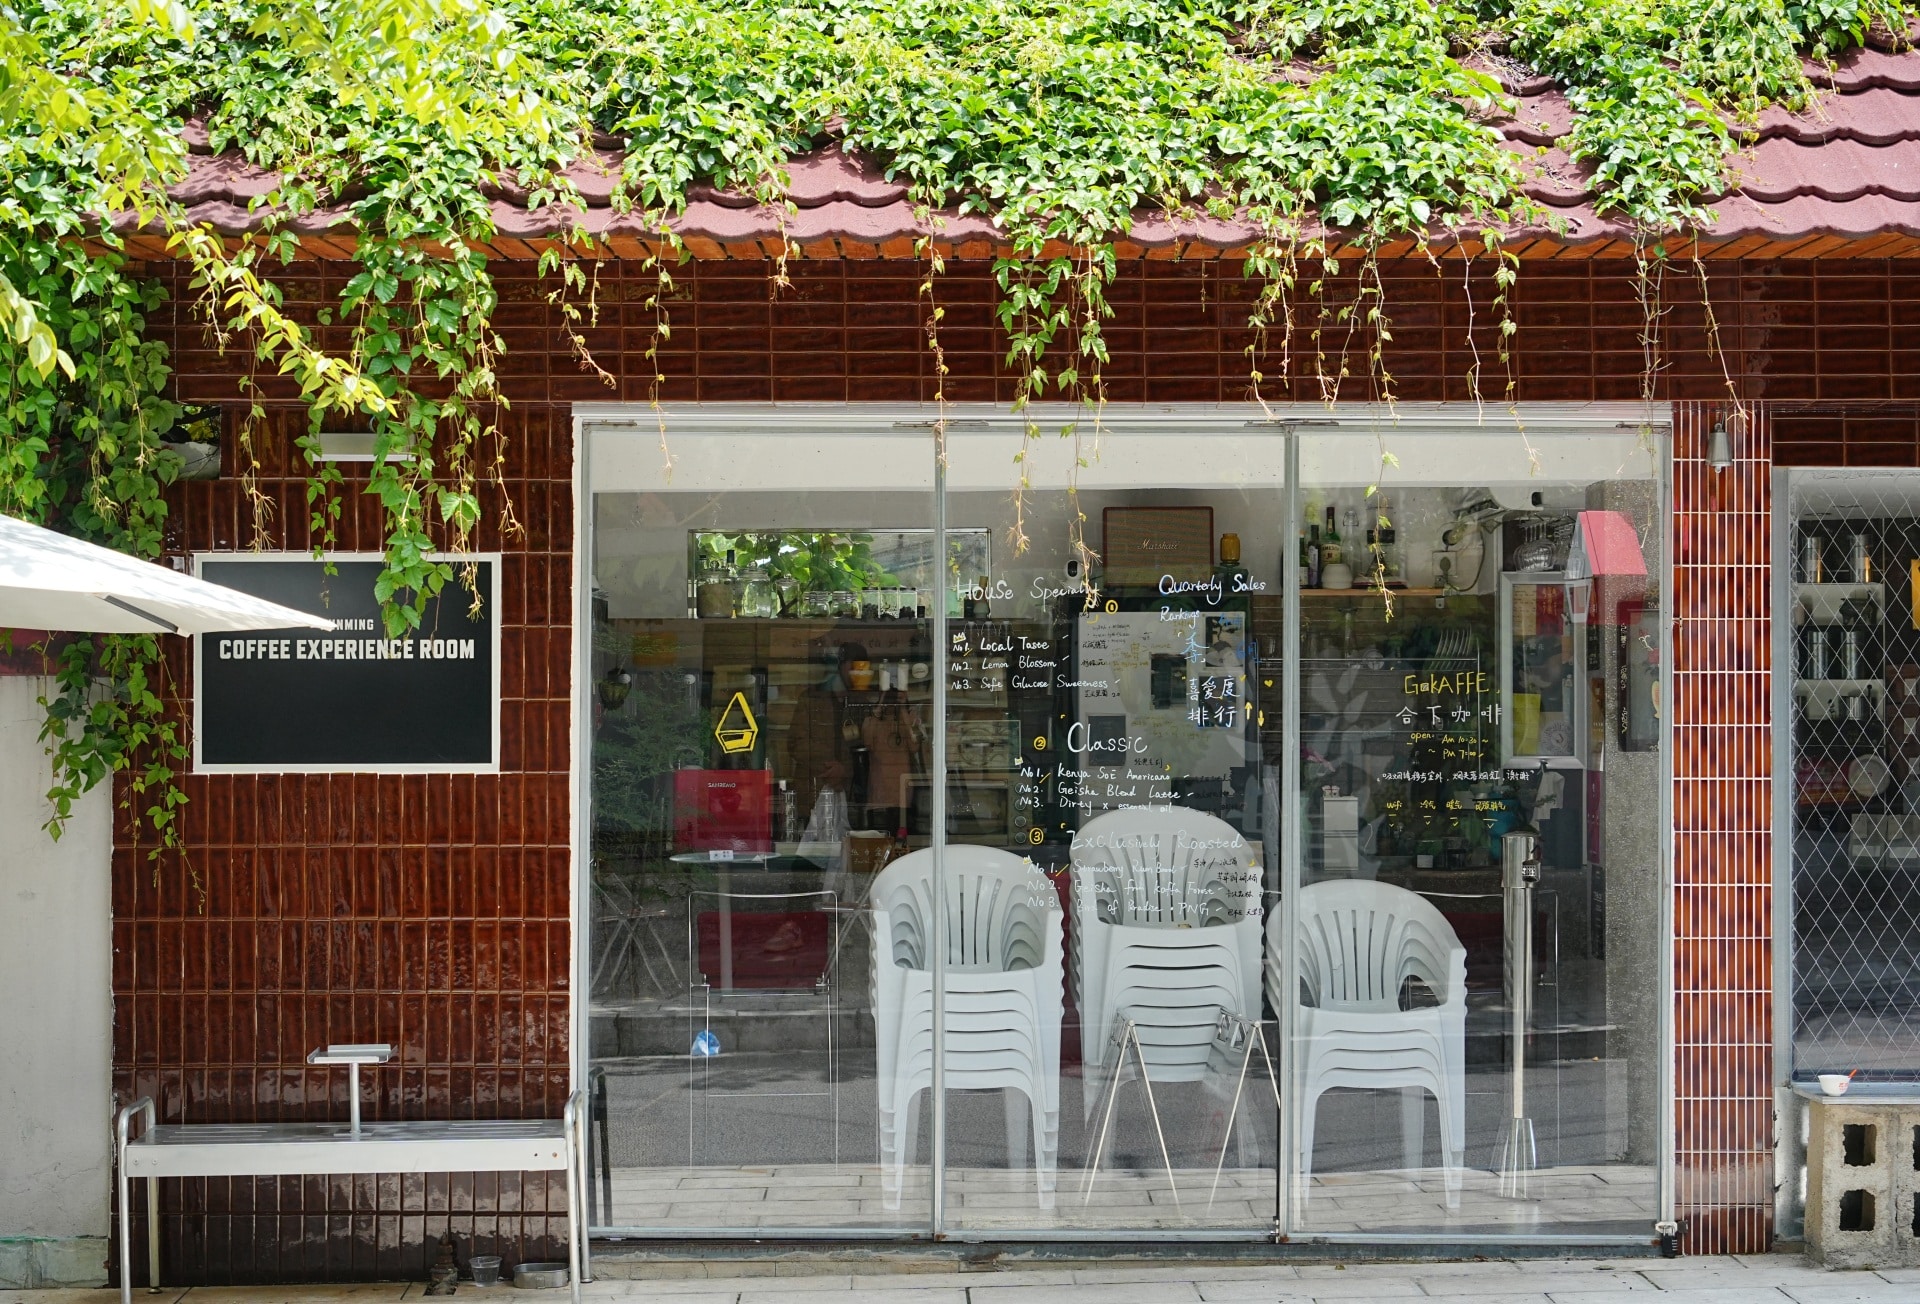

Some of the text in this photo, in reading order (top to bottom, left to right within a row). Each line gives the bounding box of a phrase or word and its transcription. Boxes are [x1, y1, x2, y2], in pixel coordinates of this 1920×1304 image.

[1159, 573, 1267, 605] Quarterly Sales
[329, 618, 374, 631] NMING
[219, 639, 475, 659] COFFEE EXPERIENCE ROOM
[981, 636, 1014, 652] Local
[982, 657, 1009, 670] Lemon
[1018, 655, 1058, 669] Blossom
[1012, 675, 1049, 688] Glucose
[1188, 705, 1238, 728] 排行
[1067, 722, 1148, 753] Classic
[1126, 768, 1171, 781] Americano
[1058, 782, 1099, 796] Geisha
[1107, 785, 1137, 797] Blend
[1060, 796, 1092, 816] Dirty
[1177, 830, 1243, 849] Roasted
[1075, 879, 1117, 893] Geisha
